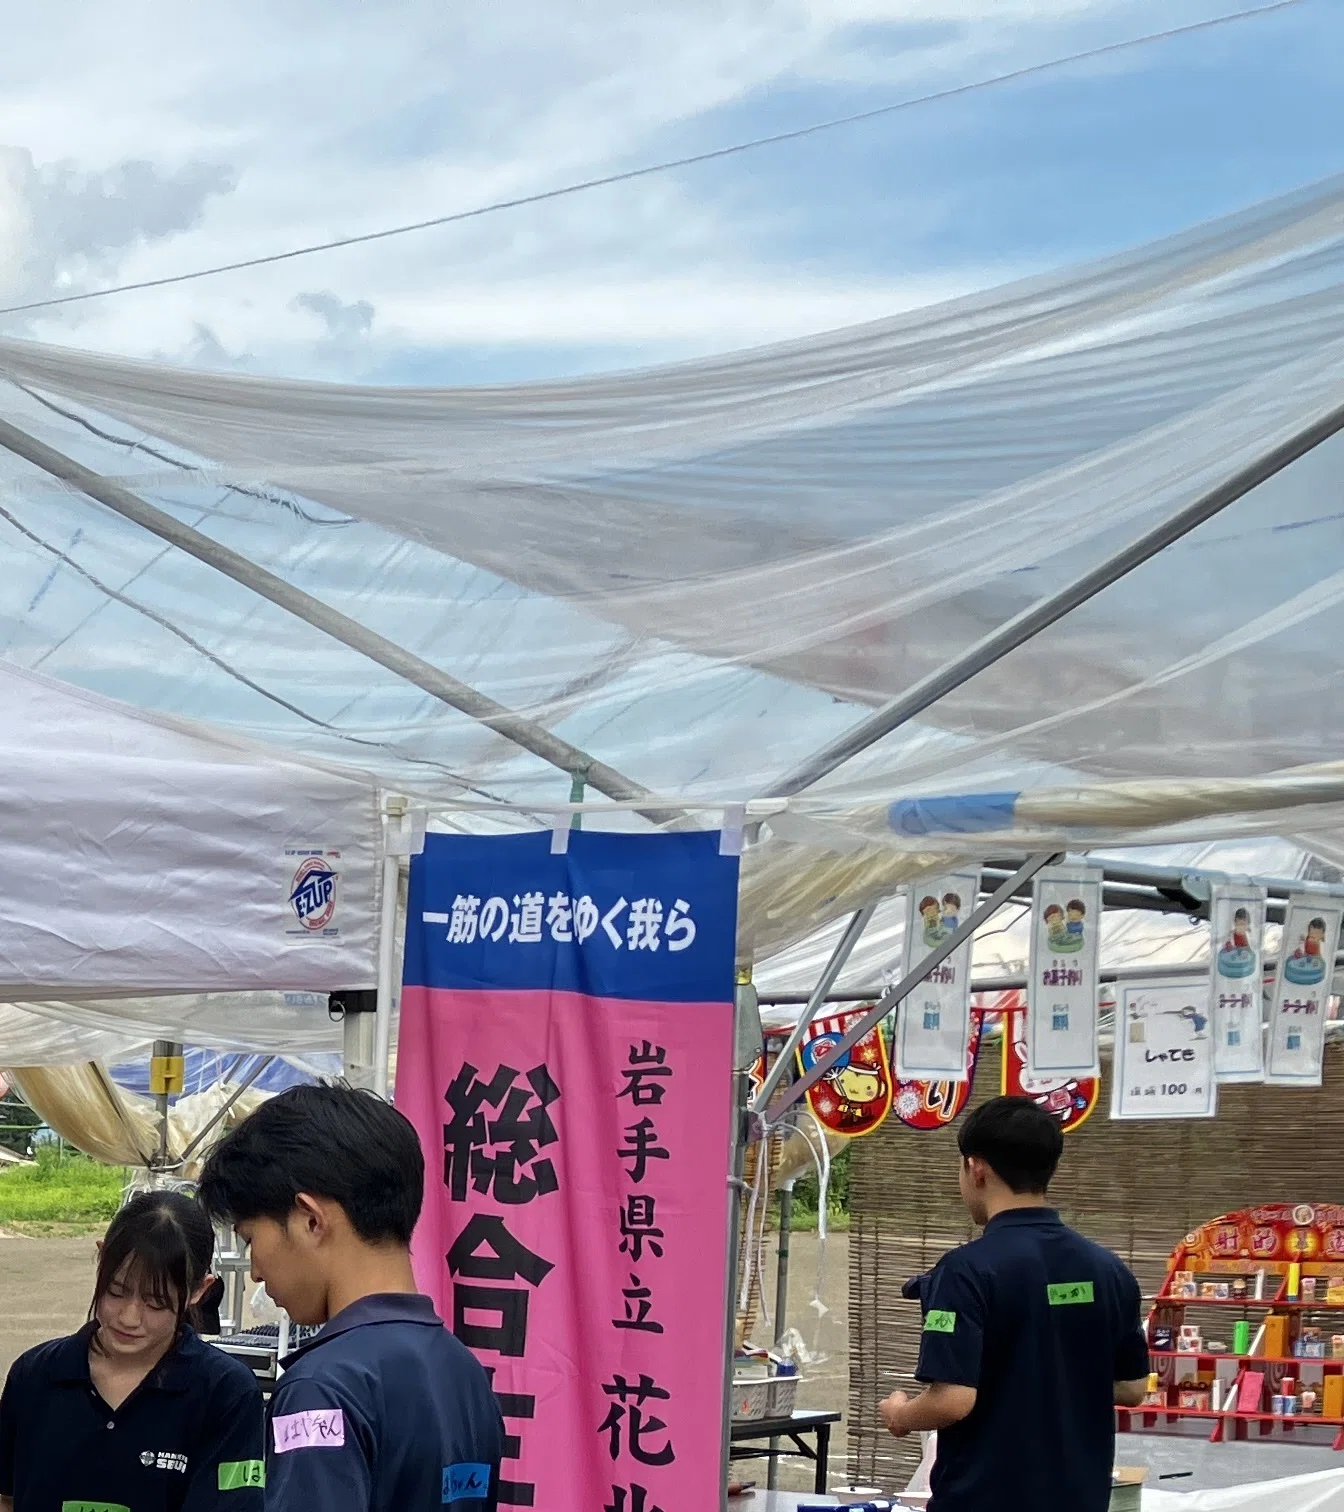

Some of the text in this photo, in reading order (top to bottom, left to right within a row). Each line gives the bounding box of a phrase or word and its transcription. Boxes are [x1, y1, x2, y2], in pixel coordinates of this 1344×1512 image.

[422, 892, 697, 952] 一筋の道をゆく我ら
[612, 1039, 673, 1334] 岩手県立
